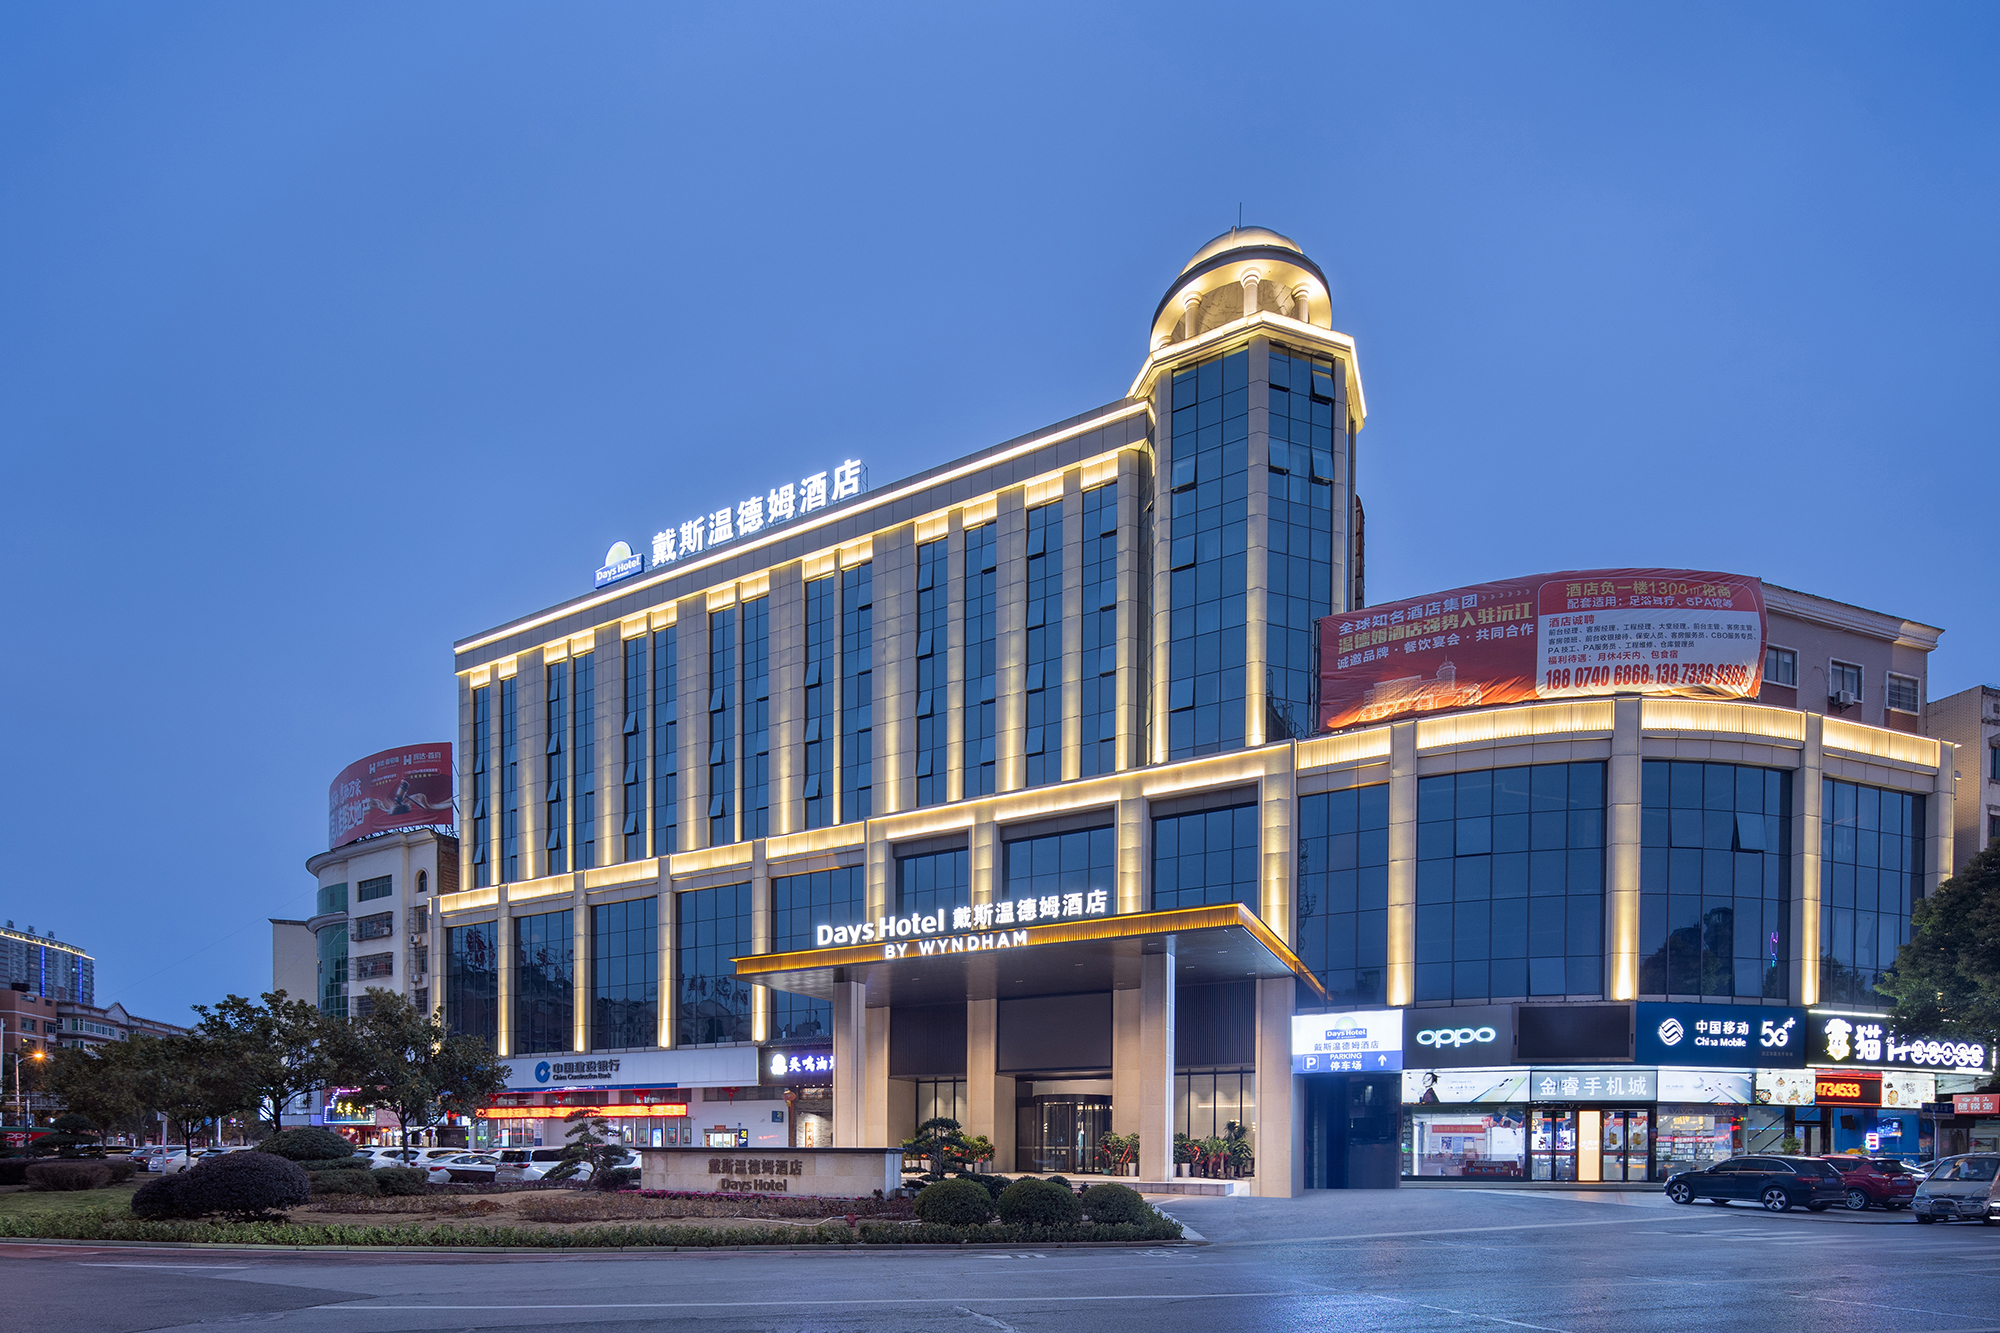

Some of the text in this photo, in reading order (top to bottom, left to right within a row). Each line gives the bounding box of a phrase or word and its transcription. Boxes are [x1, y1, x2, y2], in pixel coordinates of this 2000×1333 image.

[651, 458, 862, 567] 戴斯温德姆酒店
[596, 567, 617, 582] Days
[617, 557, 641, 573] Hotel
[1338, 593, 1478, 636] 全球知名酒店集团
[1549, 614, 1595, 628] 酒店诚聘
[1338, 602, 1533, 655] 温德姆酒店强势入驻沅江
[1546, 668, 1571, 690] 188
[1574, 665, 1610, 688] 0740
[1613, 663, 1650, 686] 6868
[1655, 663, 1679, 684] 138
[1681, 663, 1714, 685] 7339
[816, 889, 1108, 946] Days Hotel 戴斯温德姆酒店
[884, 930, 1028, 959] BY WYNDHAM
[1695, 1019, 1749, 1035] 中国移动
[1314, 1040, 1379, 1051] 戴斯温德姆酒店
[1720, 1037, 1747, 1047] Mobile
[552, 1059, 620, 1074] 中国建设银行
[1330, 1061, 1362, 1071] 停车场
[1539, 1076, 1647, 1096] 金睿手机城
[6, 1132, 32, 1140] ppo
[708, 1158, 802, 1175] 戴斯温德姆酒店
[721, 1178, 787, 1192] Days Hotel
